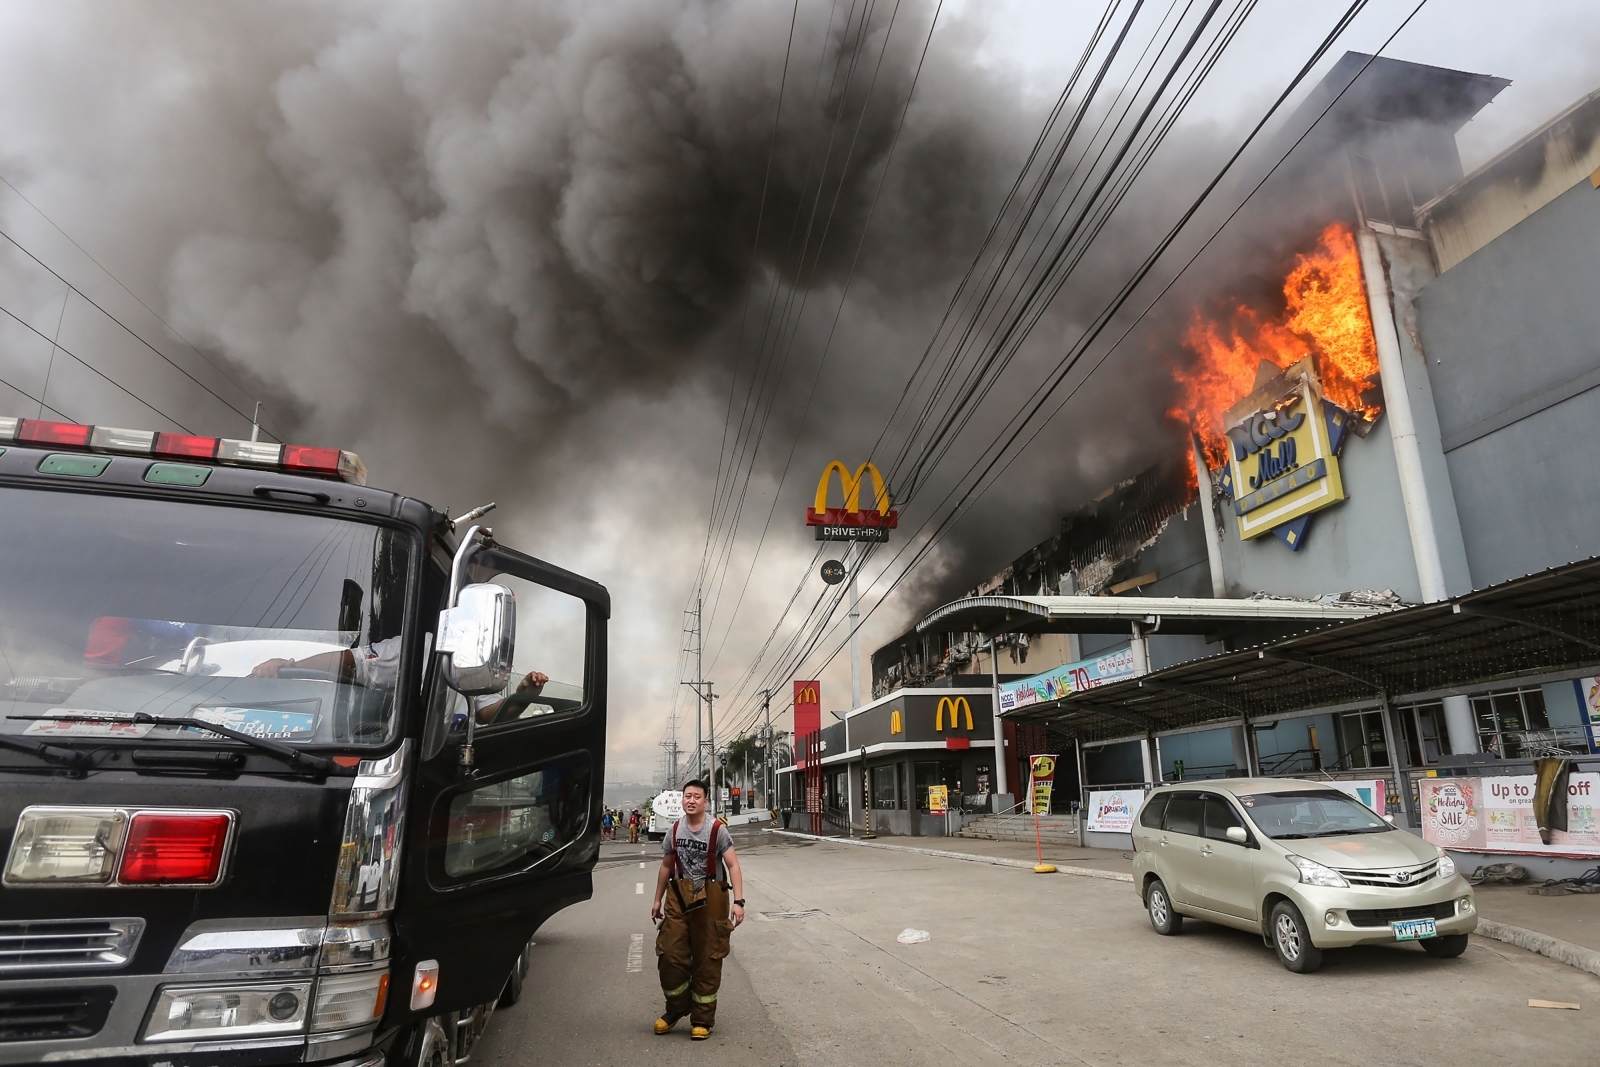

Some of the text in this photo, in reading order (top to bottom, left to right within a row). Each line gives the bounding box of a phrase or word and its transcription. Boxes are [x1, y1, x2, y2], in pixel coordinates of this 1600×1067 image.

[1225, 394, 1306, 461] NCCC
[1249, 437, 1299, 488] Mall
[1241, 465, 1316, 512] DAVAO
[1015, 673, 1073, 702] Holiday SALE
[1068, 667, 1091, 691] 70
[1001, 693, 1014, 702] NCCC
[1491, 781, 1591, 799] Up to off
[1437, 796, 1465, 809] Holiday
[1441, 811, 1463, 825] SALE
[676, 838, 708, 852] HILFIGER
[1417, 922, 1434, 933] 773
